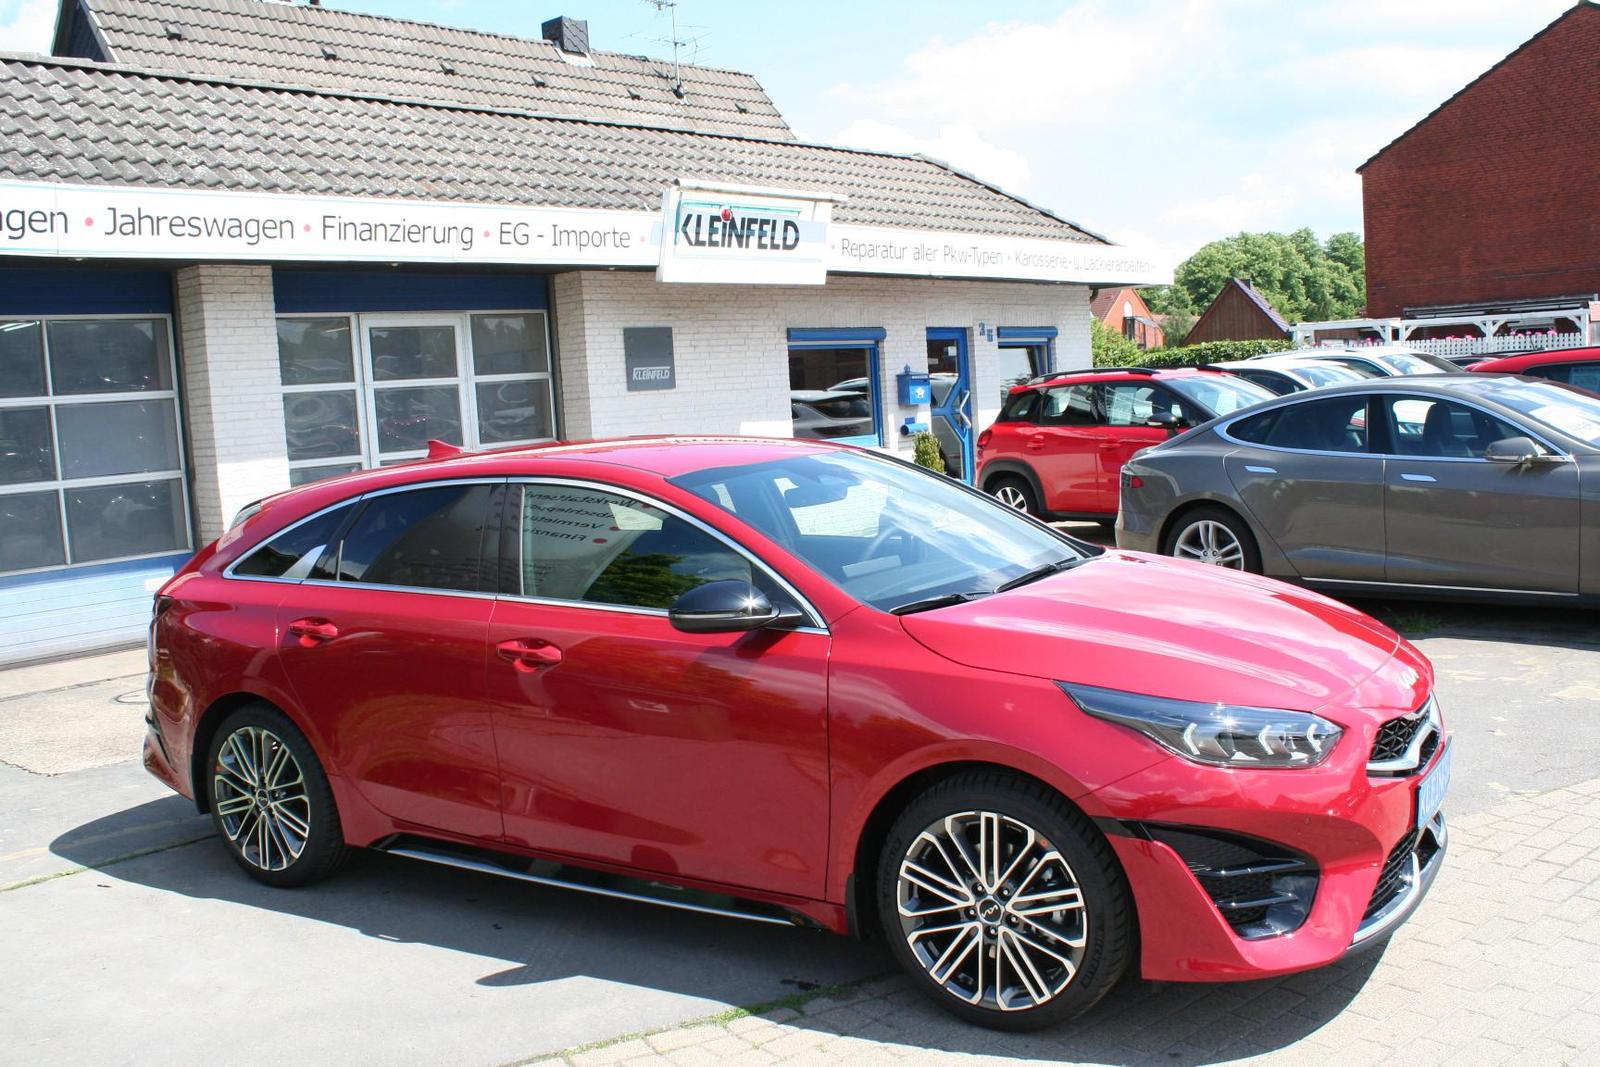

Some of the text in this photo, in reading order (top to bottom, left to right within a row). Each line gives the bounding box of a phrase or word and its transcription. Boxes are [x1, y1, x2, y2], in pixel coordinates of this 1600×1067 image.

[0, 209, 68, 240] gen
[105, 207, 294, 245] Jahreswagen
[322, 215, 473, 250] Finanzierung
[499, 222, 529, 246] EG
[552, 225, 630, 252] Importe
[841, 238, 908, 262] Reparatur
[913, 243, 938, 261] aller
[943, 245, 1003, 268] Pkw-Typen
